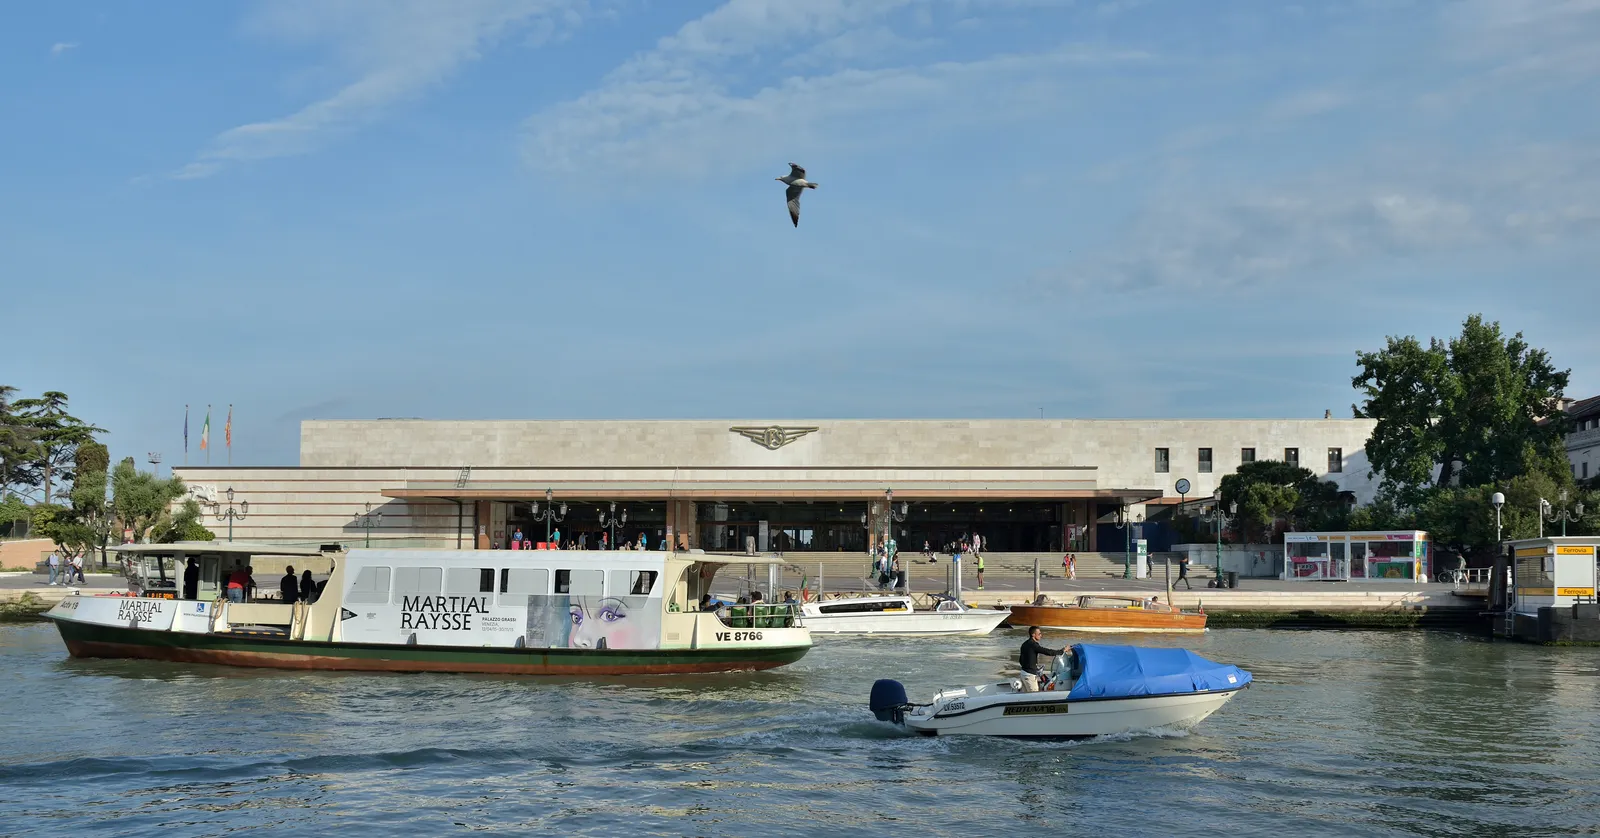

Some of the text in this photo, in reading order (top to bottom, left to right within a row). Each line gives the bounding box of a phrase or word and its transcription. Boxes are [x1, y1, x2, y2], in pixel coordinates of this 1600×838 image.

[119, 600, 162, 613] MARTIAL
[401, 596, 489, 613] MARTIAL
[117, 610, 153, 622] RAYSSE
[400, 613, 471, 630] RAYSSE
[715, 631, 763, 641] VE 8766
